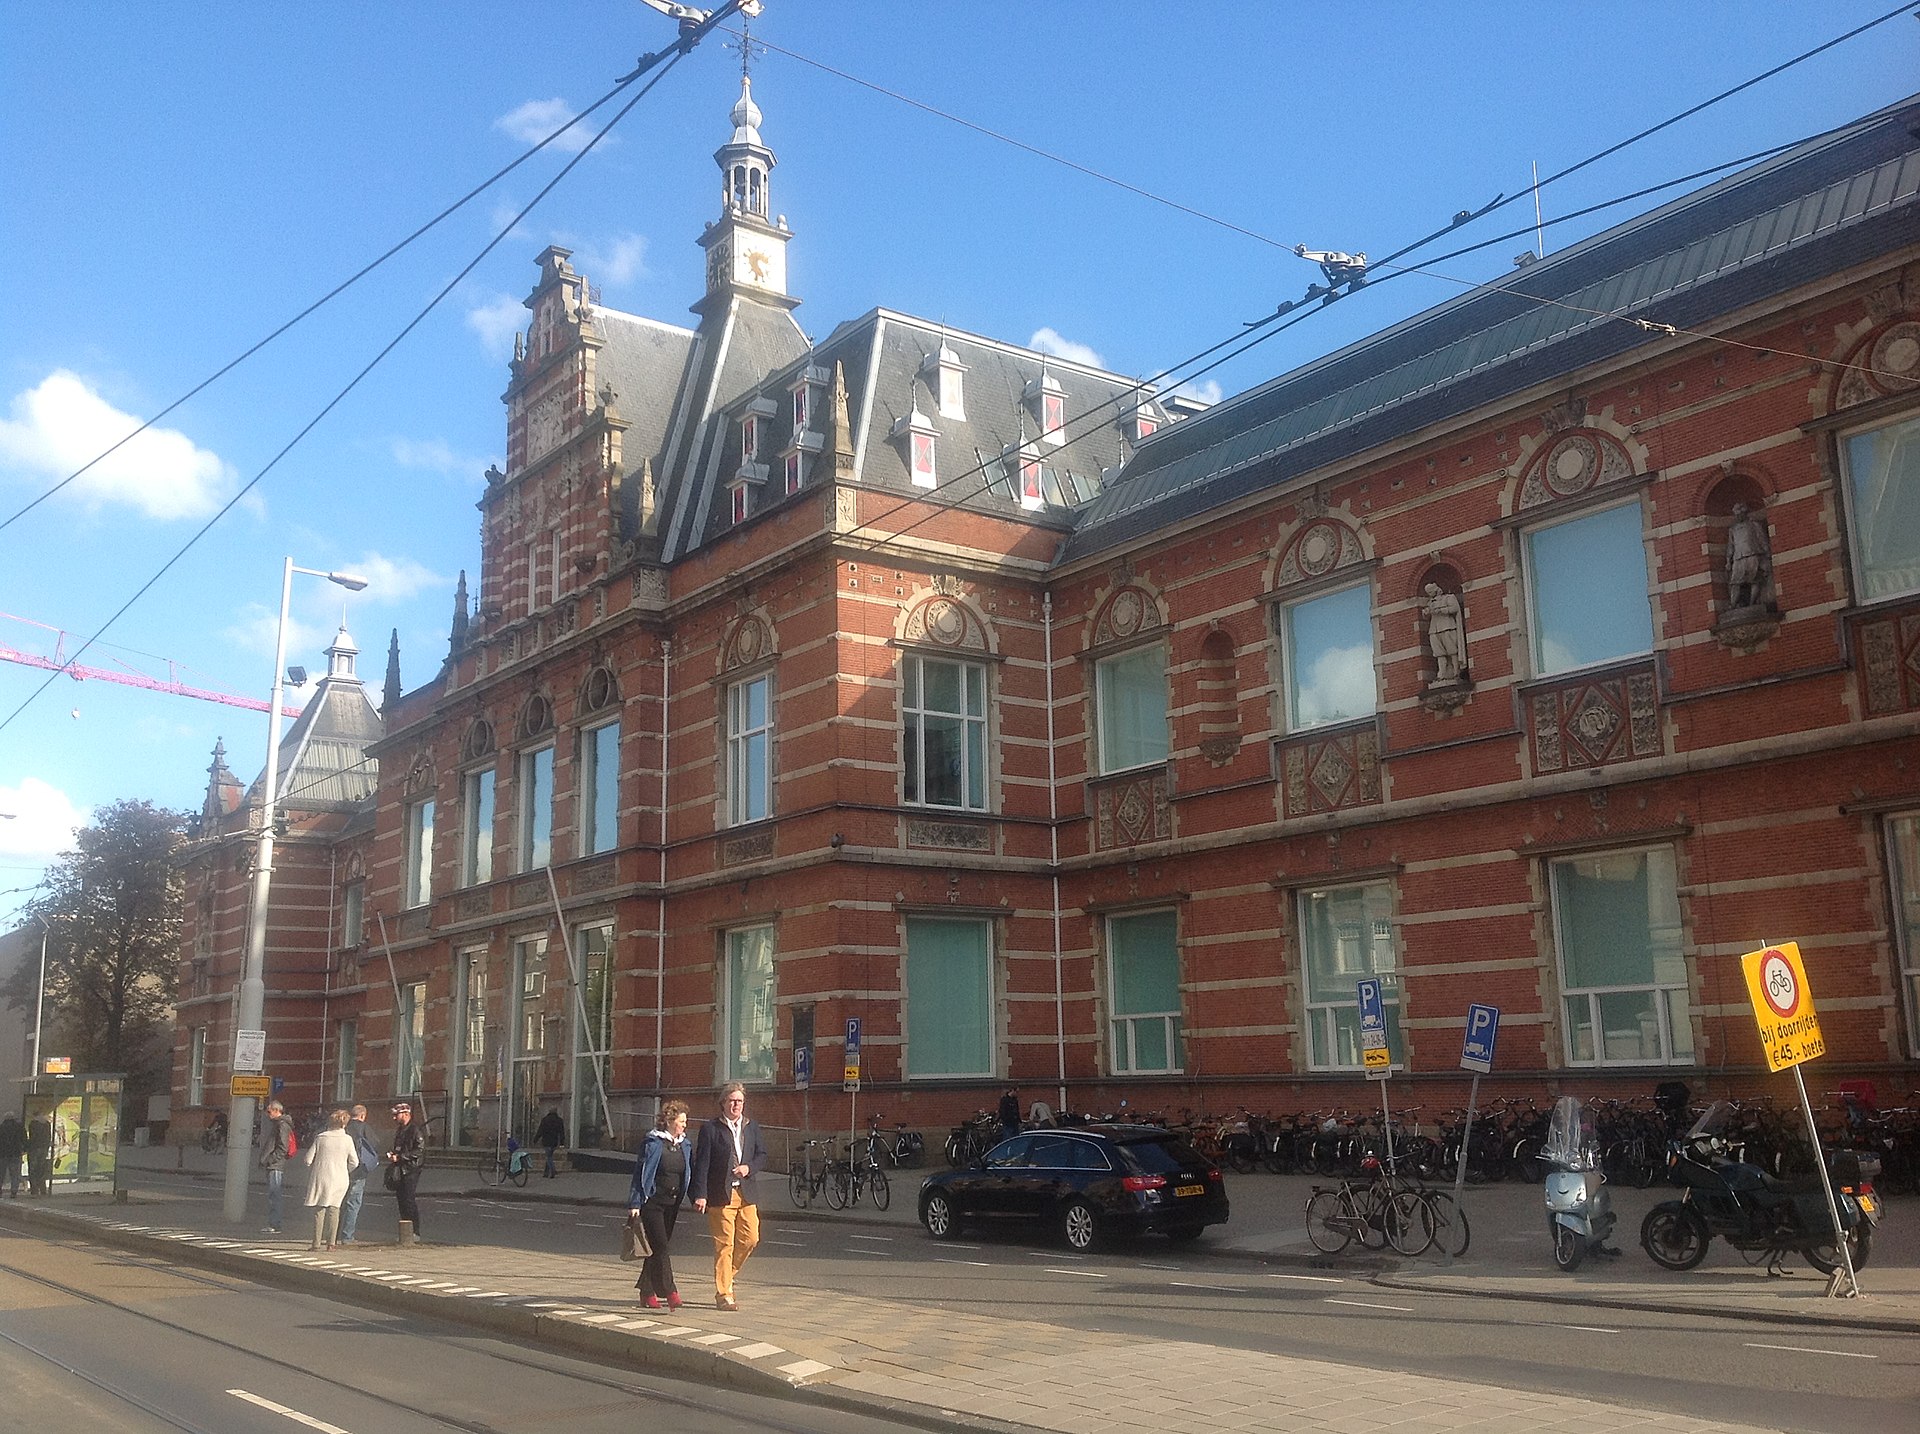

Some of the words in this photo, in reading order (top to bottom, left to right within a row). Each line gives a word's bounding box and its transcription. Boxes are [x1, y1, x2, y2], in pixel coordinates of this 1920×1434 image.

[1361, 984, 1375, 1010] P
[848, 1021, 857, 1039] P
[1471, 1008, 1490, 1036] P
[1760, 1024, 1777, 1046] bij
[1777, 1014, 1818, 1039] doorrijden
[797, 1050, 805, 1069] P
[1801, 1038, 1823, 1058] boete
